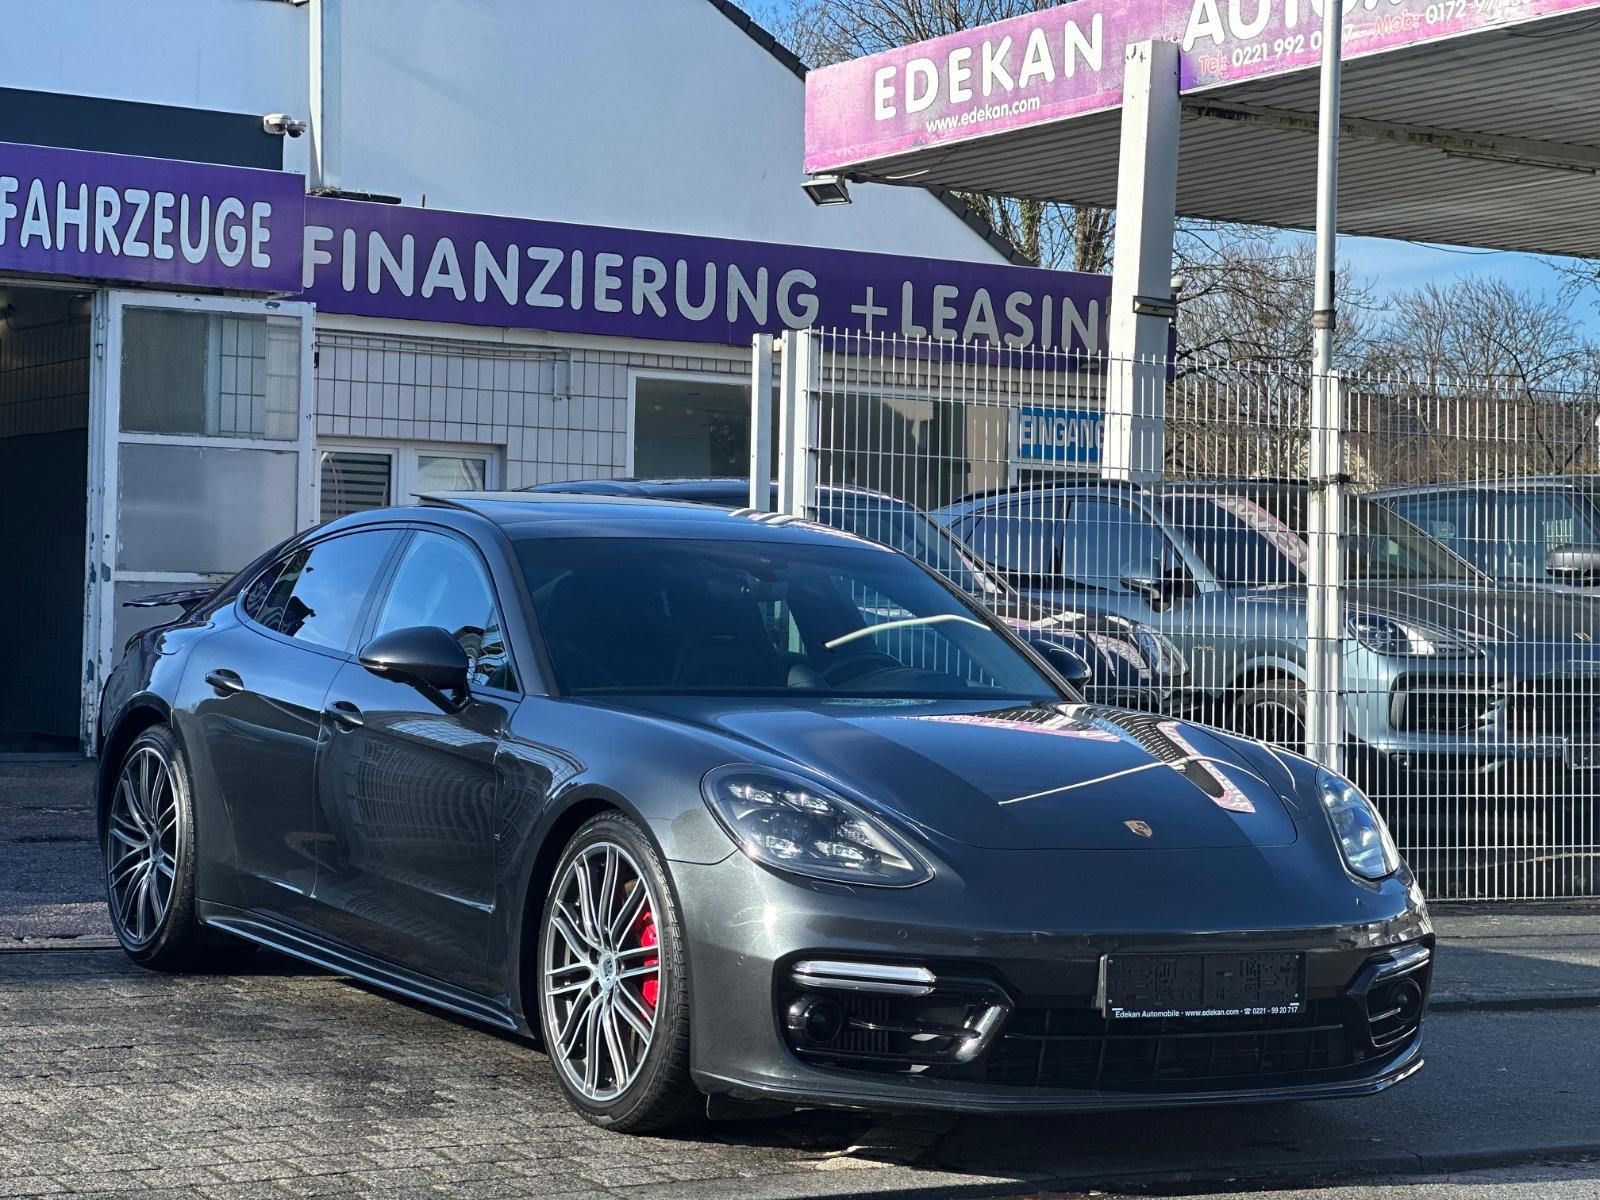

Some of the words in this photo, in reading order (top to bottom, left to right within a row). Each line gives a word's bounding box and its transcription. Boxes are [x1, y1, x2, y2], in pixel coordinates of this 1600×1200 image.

[874, 13, 1103, 121] EDEKAN
[1199, 54, 1227, 74] Tel:
[1232, 45, 1268, 67] 0221
[1274, 34, 1304, 58] 992
[1375, 9, 1419, 36] Mob:
[1425, 0, 1467, 25] 0172
[926, 95, 1040, 133] www.edekan.com
[0, 175, 272, 269] FAHRZEUGE
[303, 225, 820, 329] FINANZIERUNG
[1115, 1010, 1140, 1018] Edekan
[1142, 1009, 1180, 1018] Automobile
[1184, 1008, 1239, 1017] www.edekan.com
[1252, 1007, 1266, 1015] 0221
[1271, 1006, 1278, 1014] 99
[1279, 1006, 1287, 1014] 20
[1287, 1006, 1298, 1014] 717
